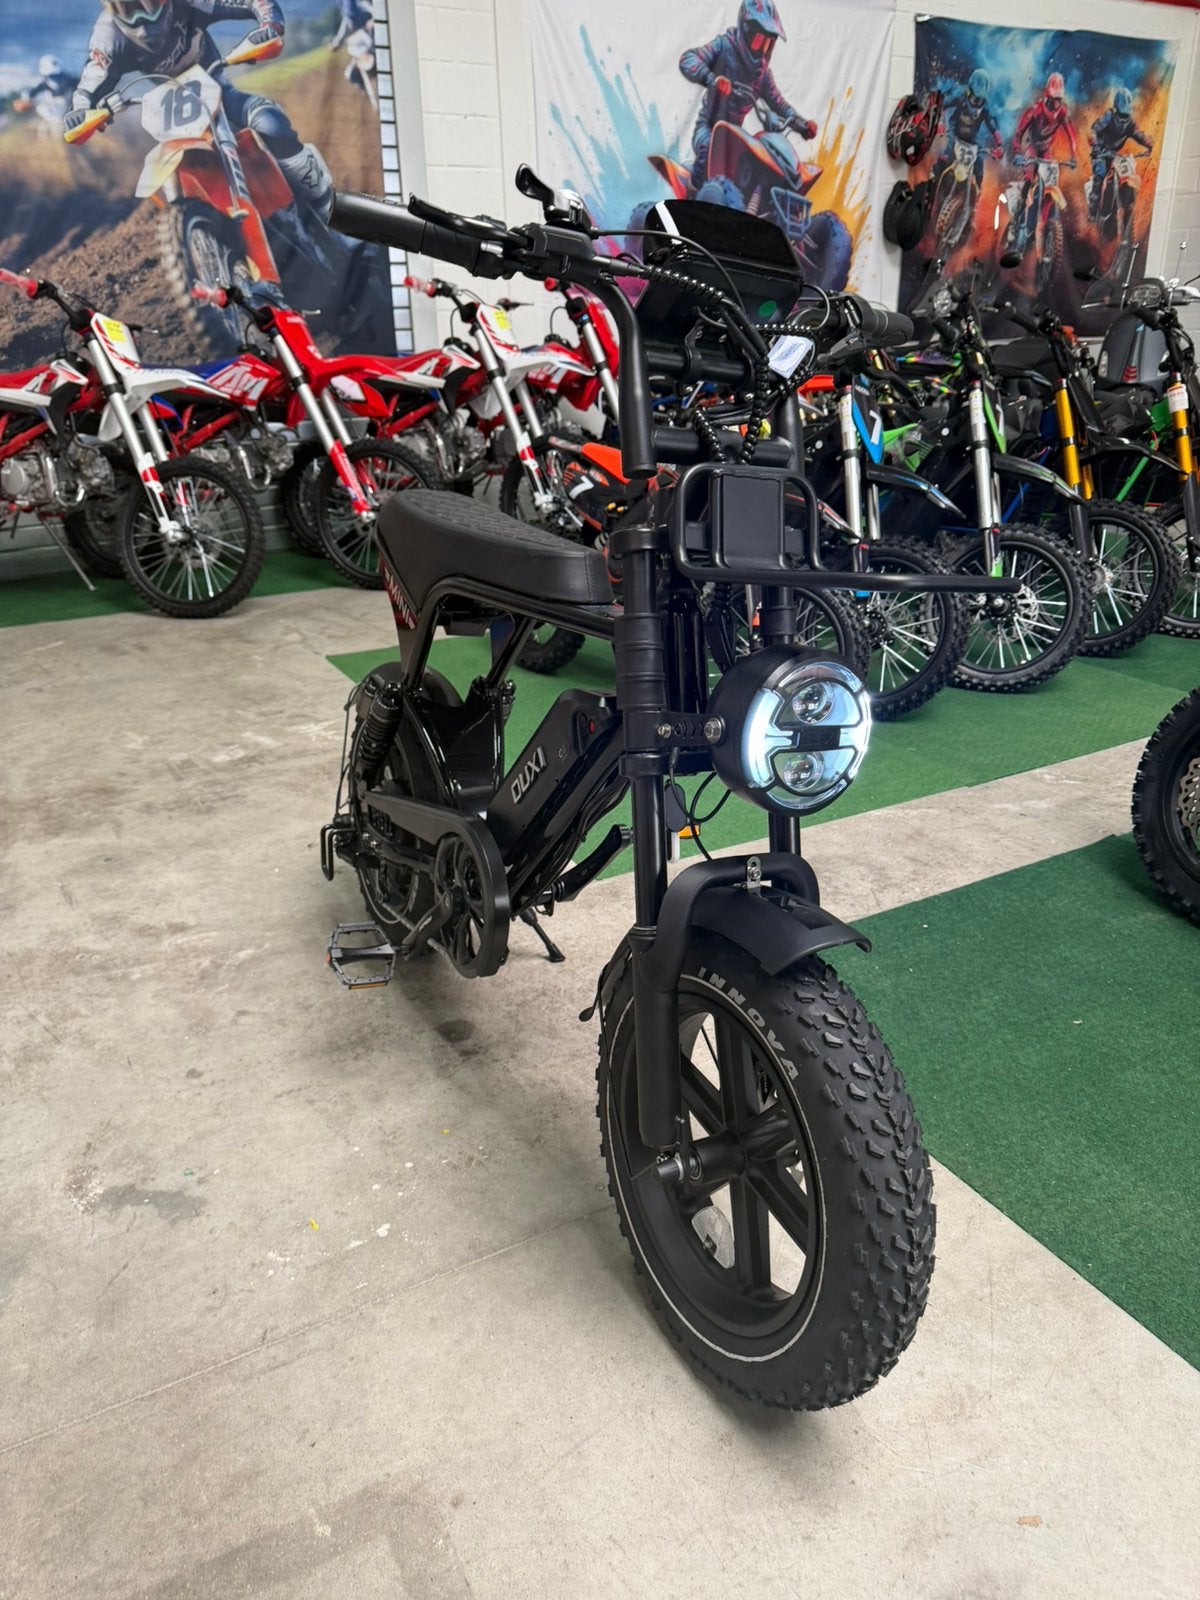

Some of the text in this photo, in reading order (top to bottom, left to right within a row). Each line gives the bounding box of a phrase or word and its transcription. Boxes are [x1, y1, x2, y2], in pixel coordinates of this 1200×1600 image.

[160, 79, 201, 132] 18
[388, 574, 411, 624] MINI
[698, 966, 799, 1081] INNOVA
